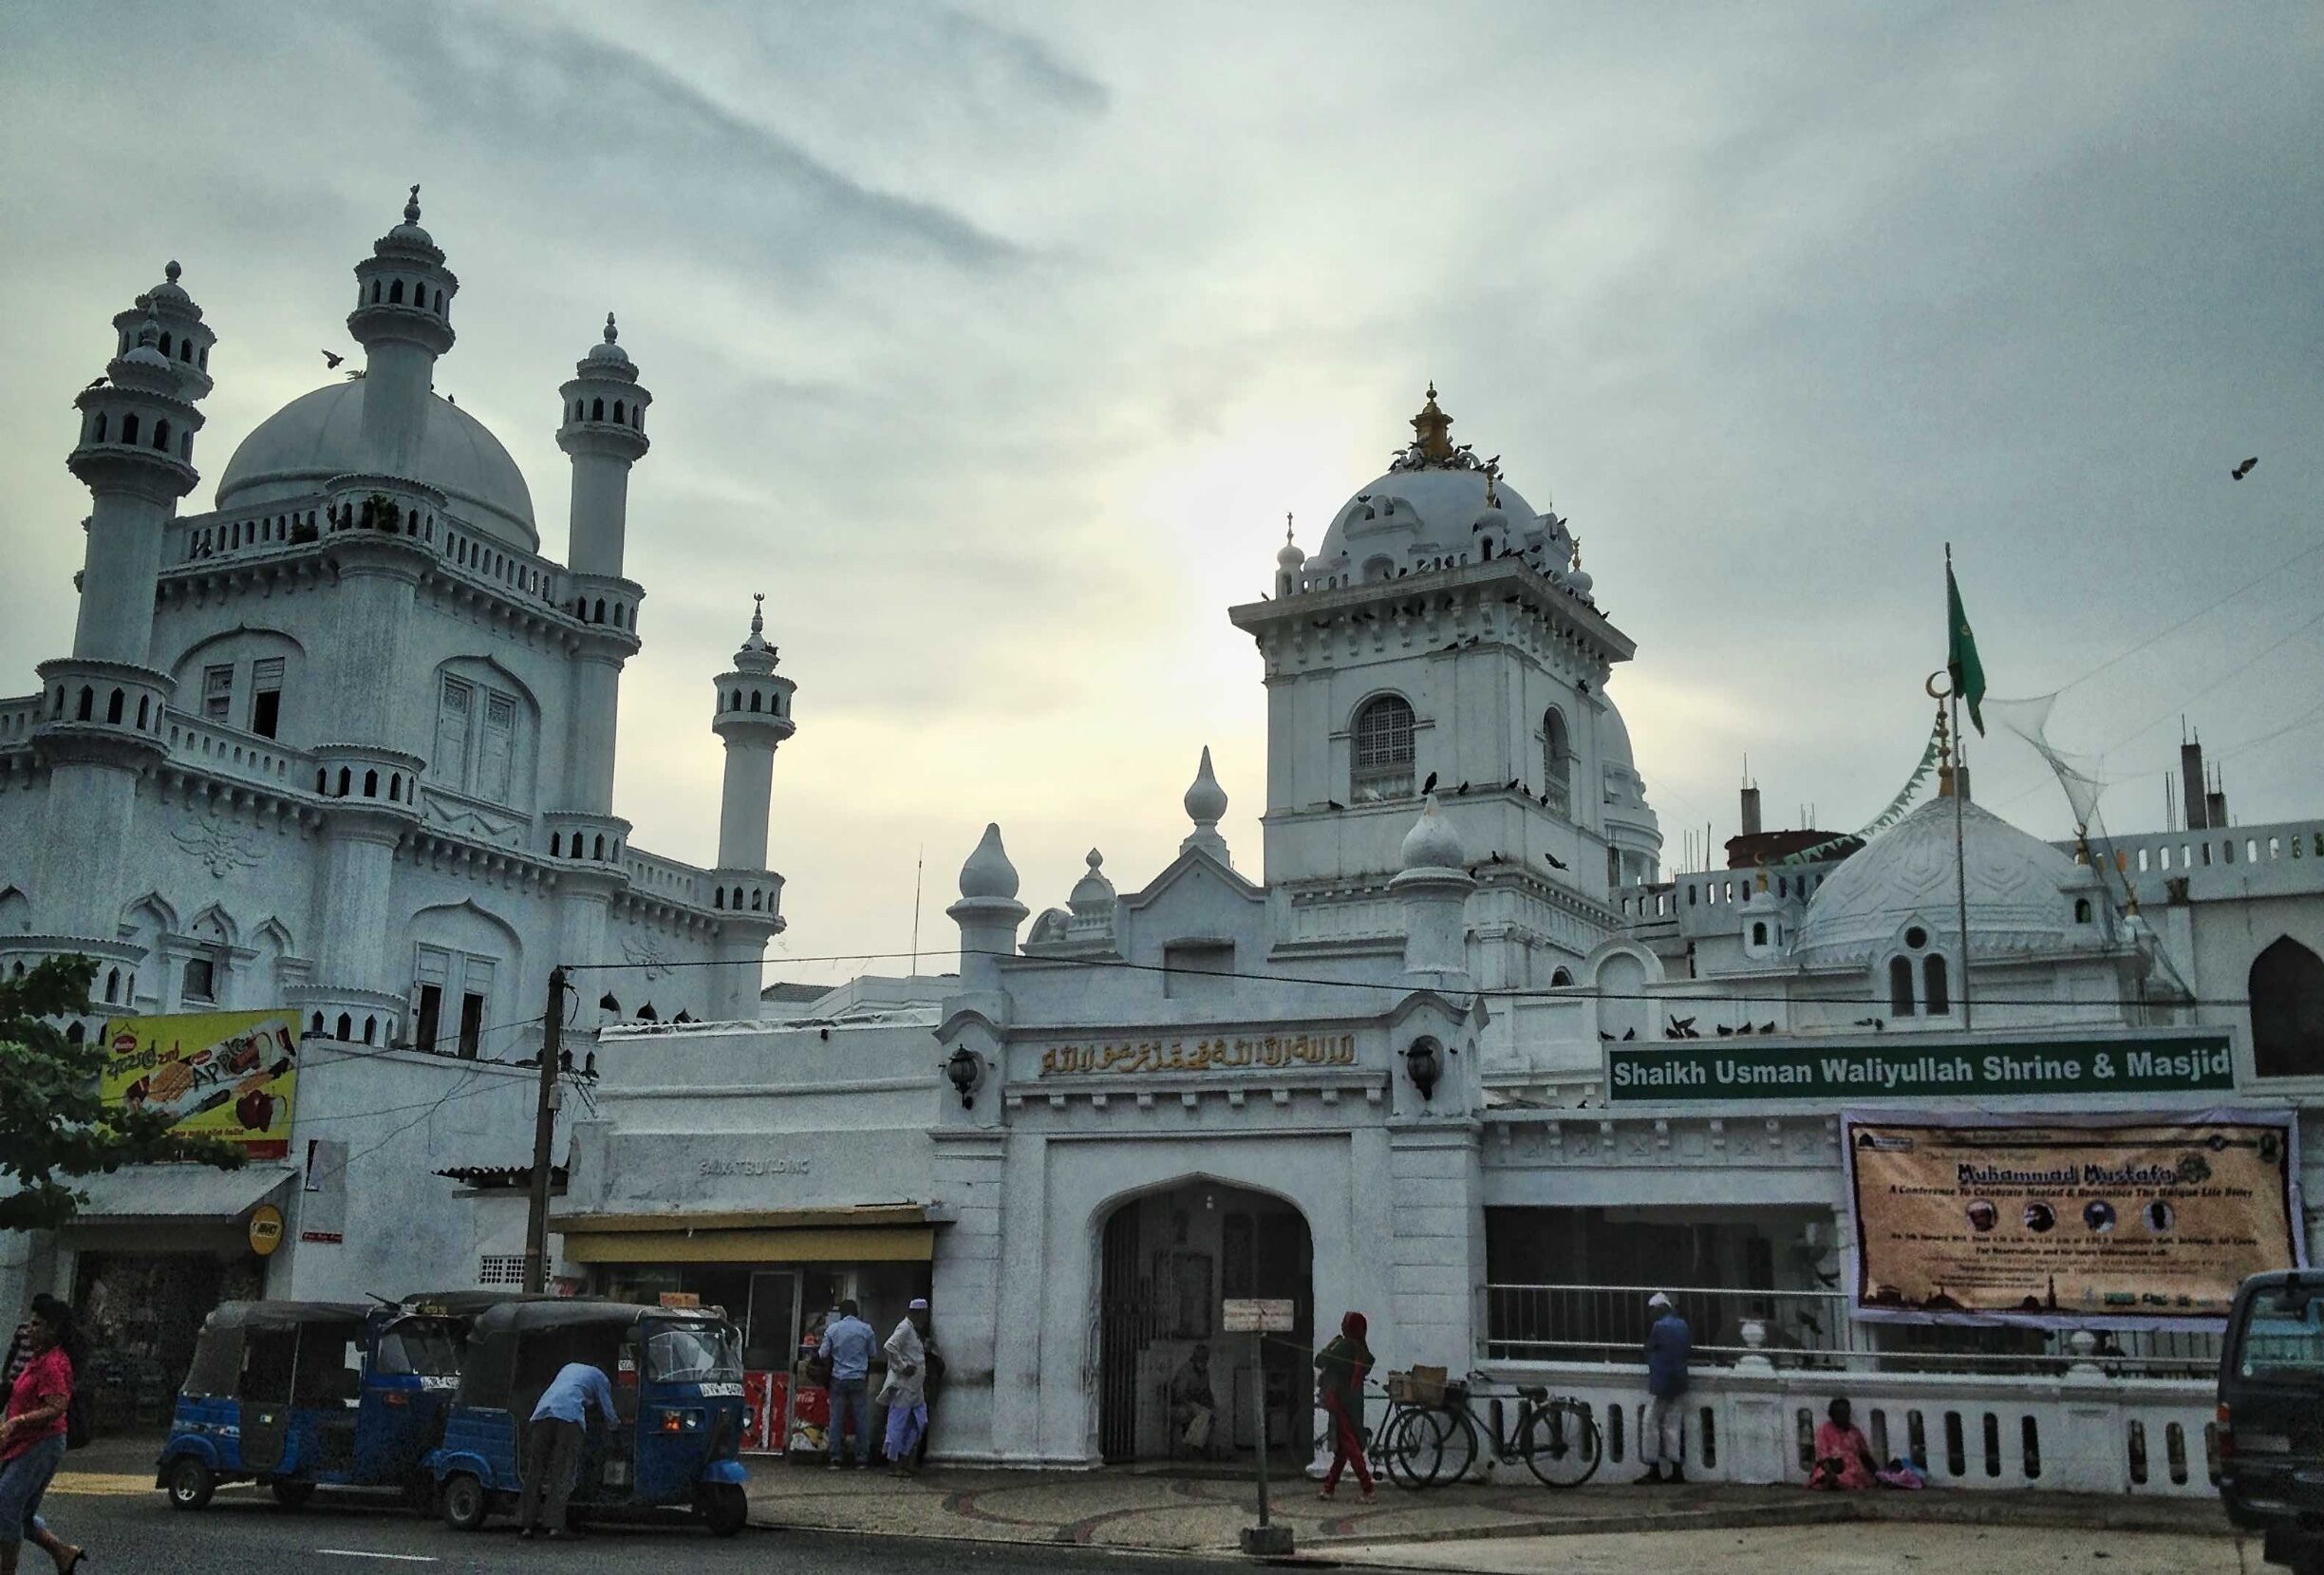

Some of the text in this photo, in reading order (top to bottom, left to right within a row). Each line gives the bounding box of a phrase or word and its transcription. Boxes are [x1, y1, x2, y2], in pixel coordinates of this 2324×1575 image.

[1614, 1048, 2230, 1089] Shaikh Usman Waliyullah Shrine & Masjid
[744, 1158, 810, 1176] BUILDING
[1958, 1163, 2177, 1183] Muhammad Mustafa
[1899, 1186, 1956, 1196] Conference
[1959, 1187, 1971, 1196] To
[1974, 1187, 2023, 1197] Celebrate
[2136, 1189, 2156, 1197] The
[2202, 1189, 2221, 1198] Life
[1993, 1247, 2041, 1256] Reservation
